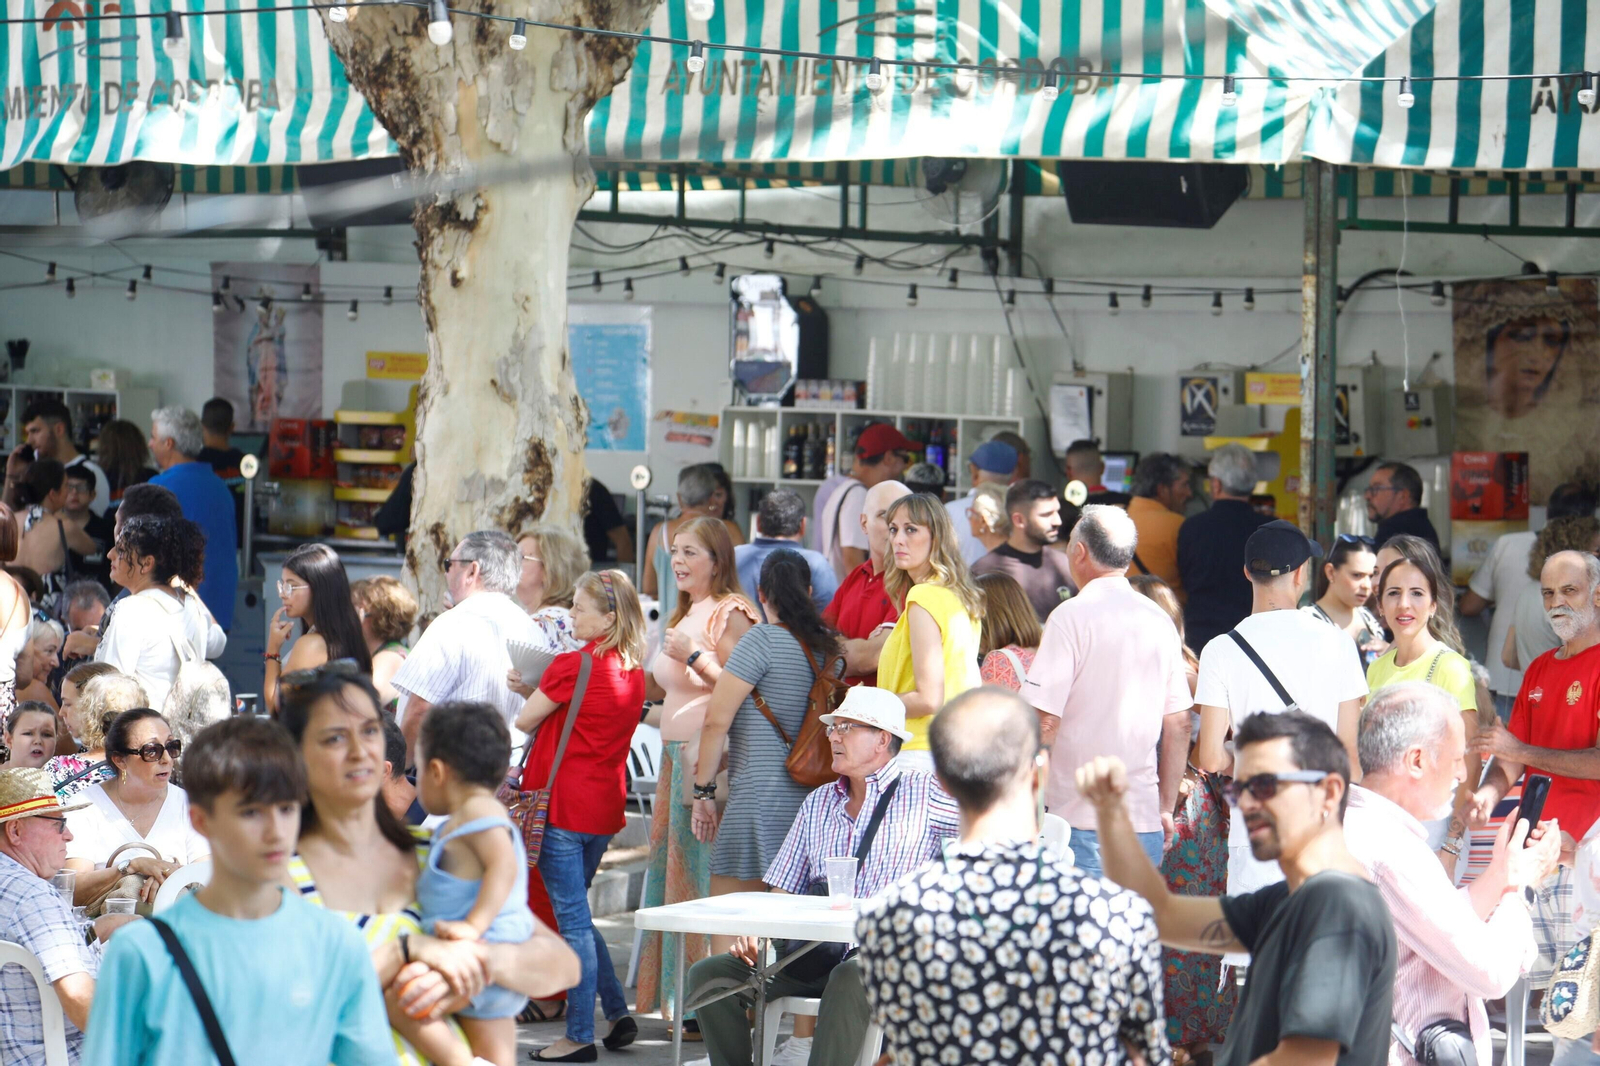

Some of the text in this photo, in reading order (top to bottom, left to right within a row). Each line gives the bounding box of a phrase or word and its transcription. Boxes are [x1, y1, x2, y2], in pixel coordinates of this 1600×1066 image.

[901, 57, 942, 96] DE
[945, 56, 1114, 98] CORDOBA
[103, 80, 140, 115] DE
